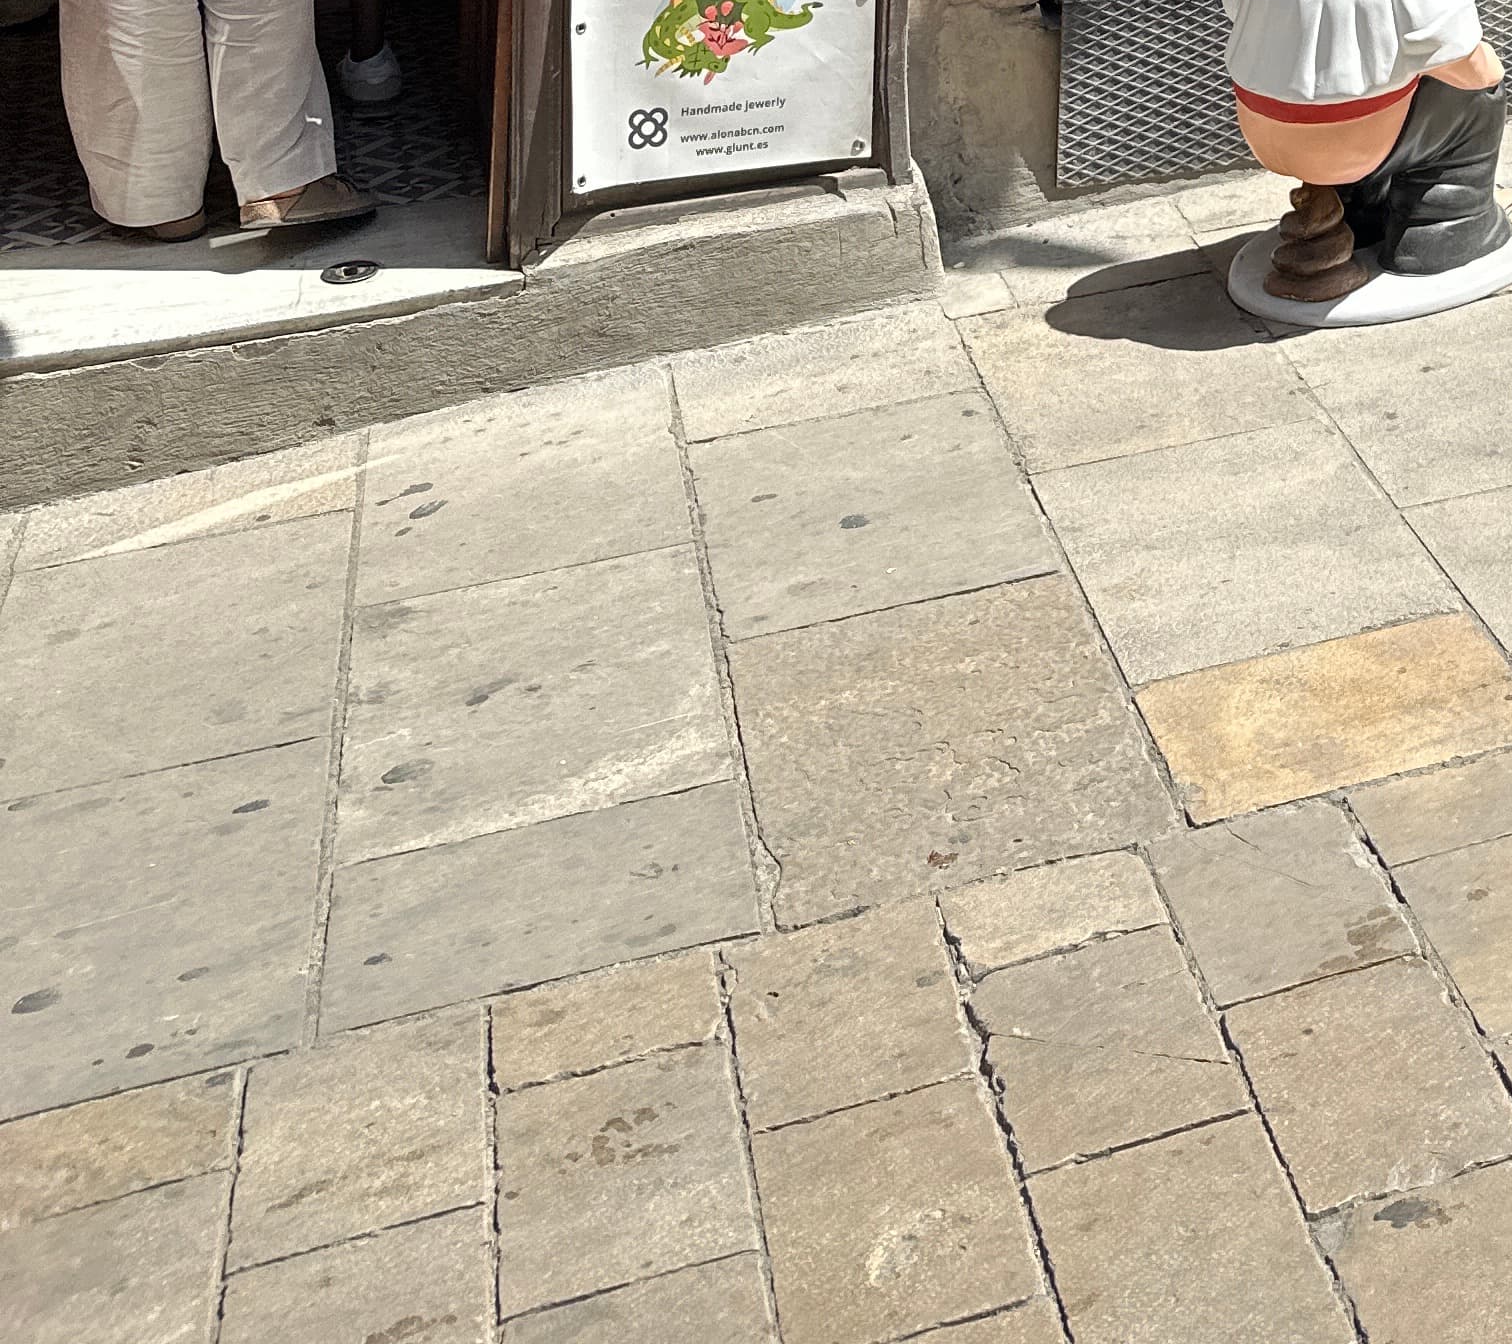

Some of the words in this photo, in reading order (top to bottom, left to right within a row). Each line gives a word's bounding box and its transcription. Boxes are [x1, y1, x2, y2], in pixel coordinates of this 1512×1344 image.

[680, 101, 743, 117] Handmade
[680, 124, 784, 143] www.alonabcn.com
[695, 141, 769, 156] www.glunt.es
